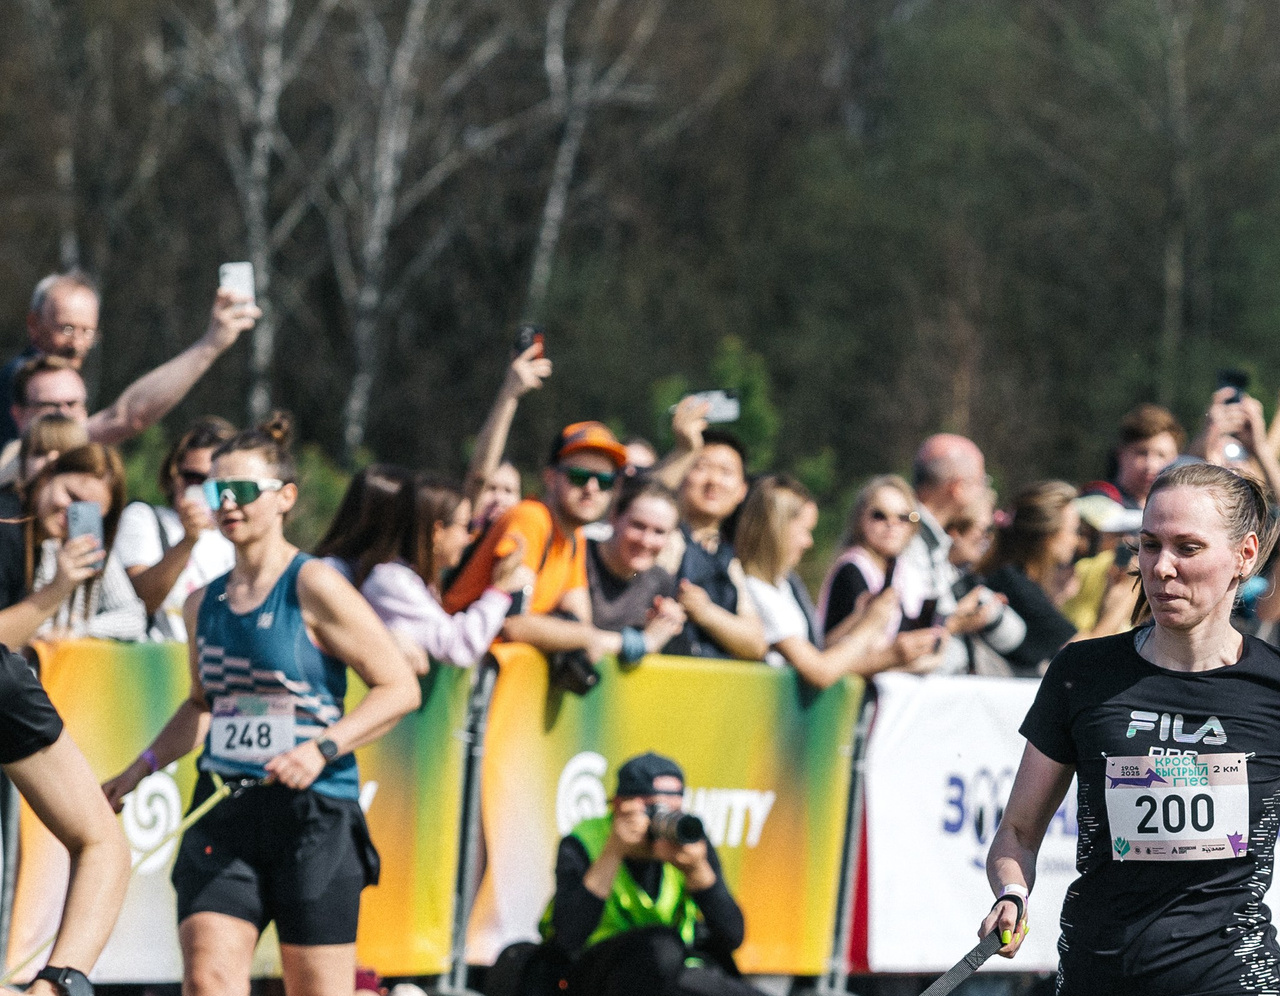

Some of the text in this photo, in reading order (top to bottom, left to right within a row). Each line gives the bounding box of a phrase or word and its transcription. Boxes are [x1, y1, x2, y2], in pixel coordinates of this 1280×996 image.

[225, 724, 271, 750] 248
[1126, 711, 1228, 745] FILA
[1213, 765, 1220, 773] 2
[1135, 793, 1215, 833] 200
